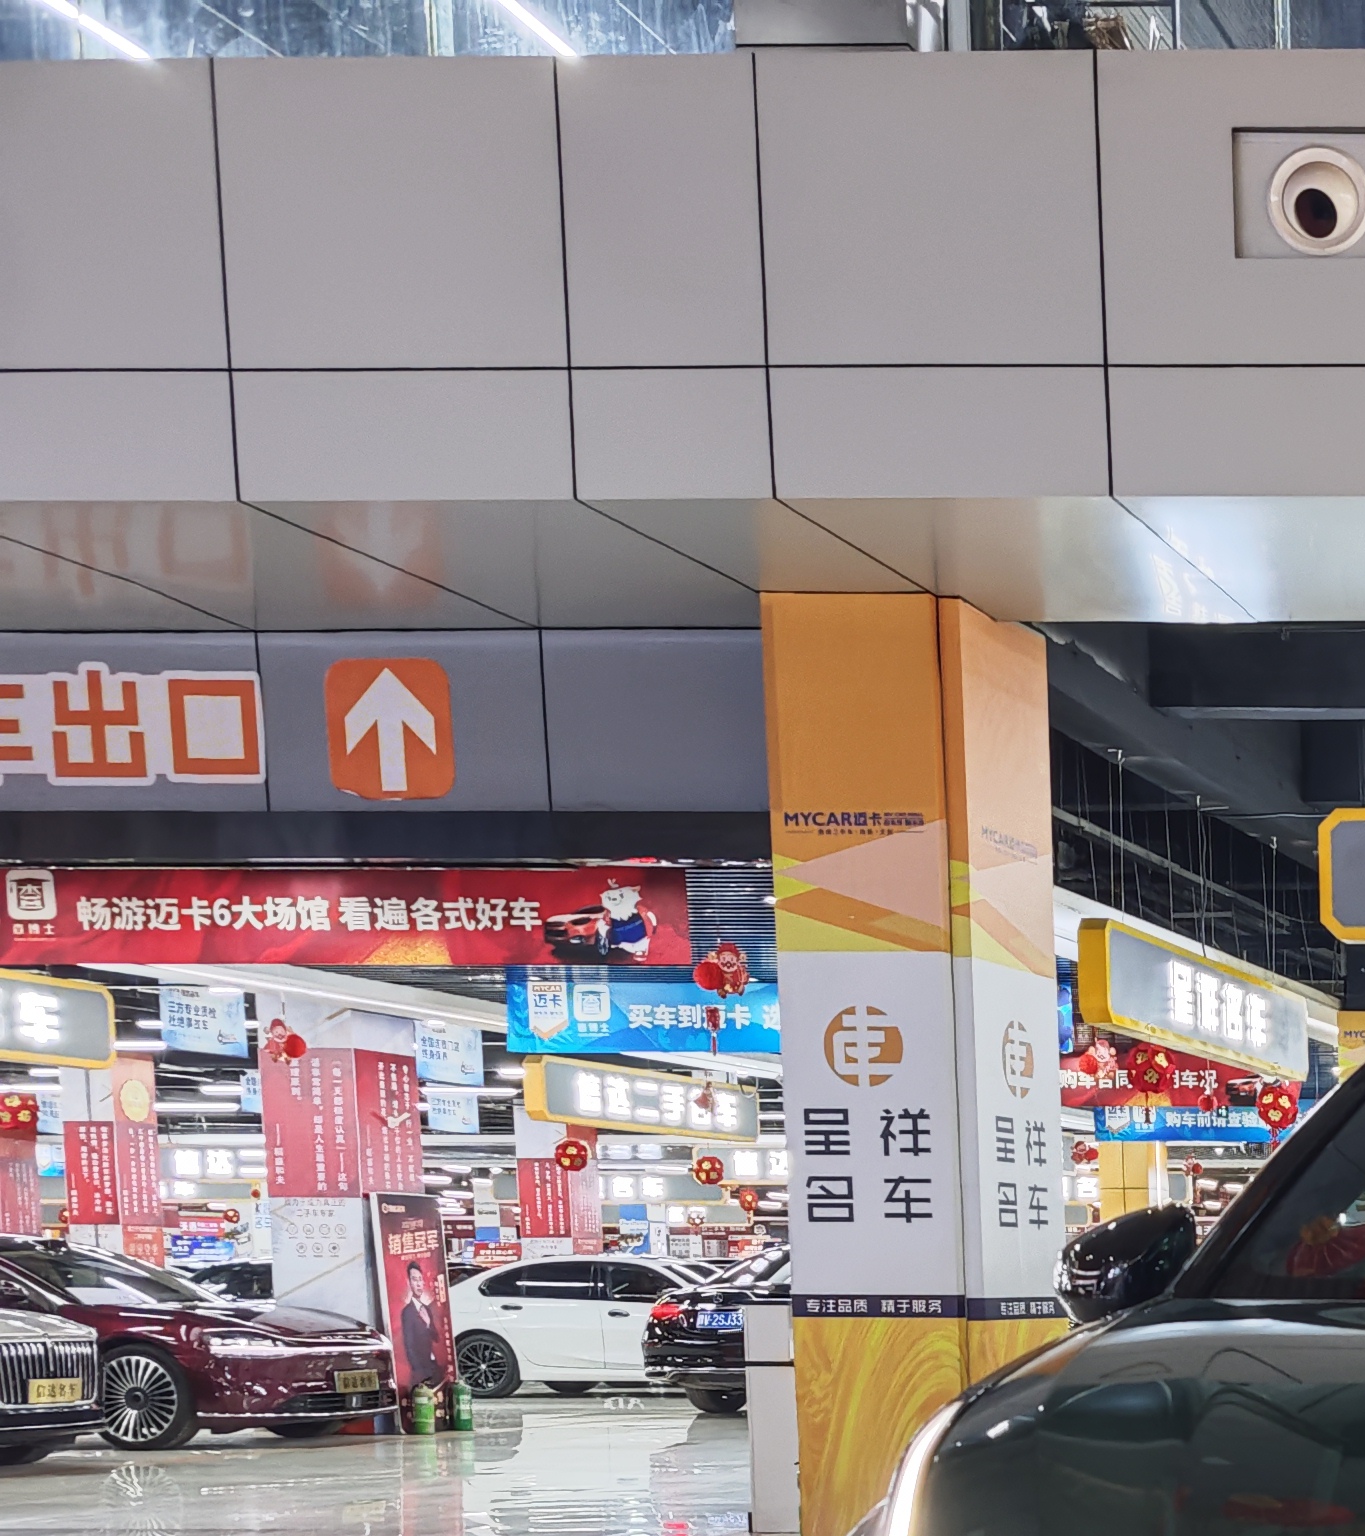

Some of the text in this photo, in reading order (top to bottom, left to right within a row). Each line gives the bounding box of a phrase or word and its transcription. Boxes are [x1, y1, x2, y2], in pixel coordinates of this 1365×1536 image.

[76, 896, 543, 932] 畅游迈卡6大场馆 看遍各式好车
[533, 994, 563, 1009] 迈卡
[577, 1071, 738, 1127] 信达二手名车
[803, 1108, 932, 1157] 呈祥
[995, 1115, 1047, 1167] 呈祥
[806, 1176, 934, 1224] 名车
[997, 1181, 1049, 1231] 名车
[806, 1298, 943, 1314] 专注品质 精于服务
